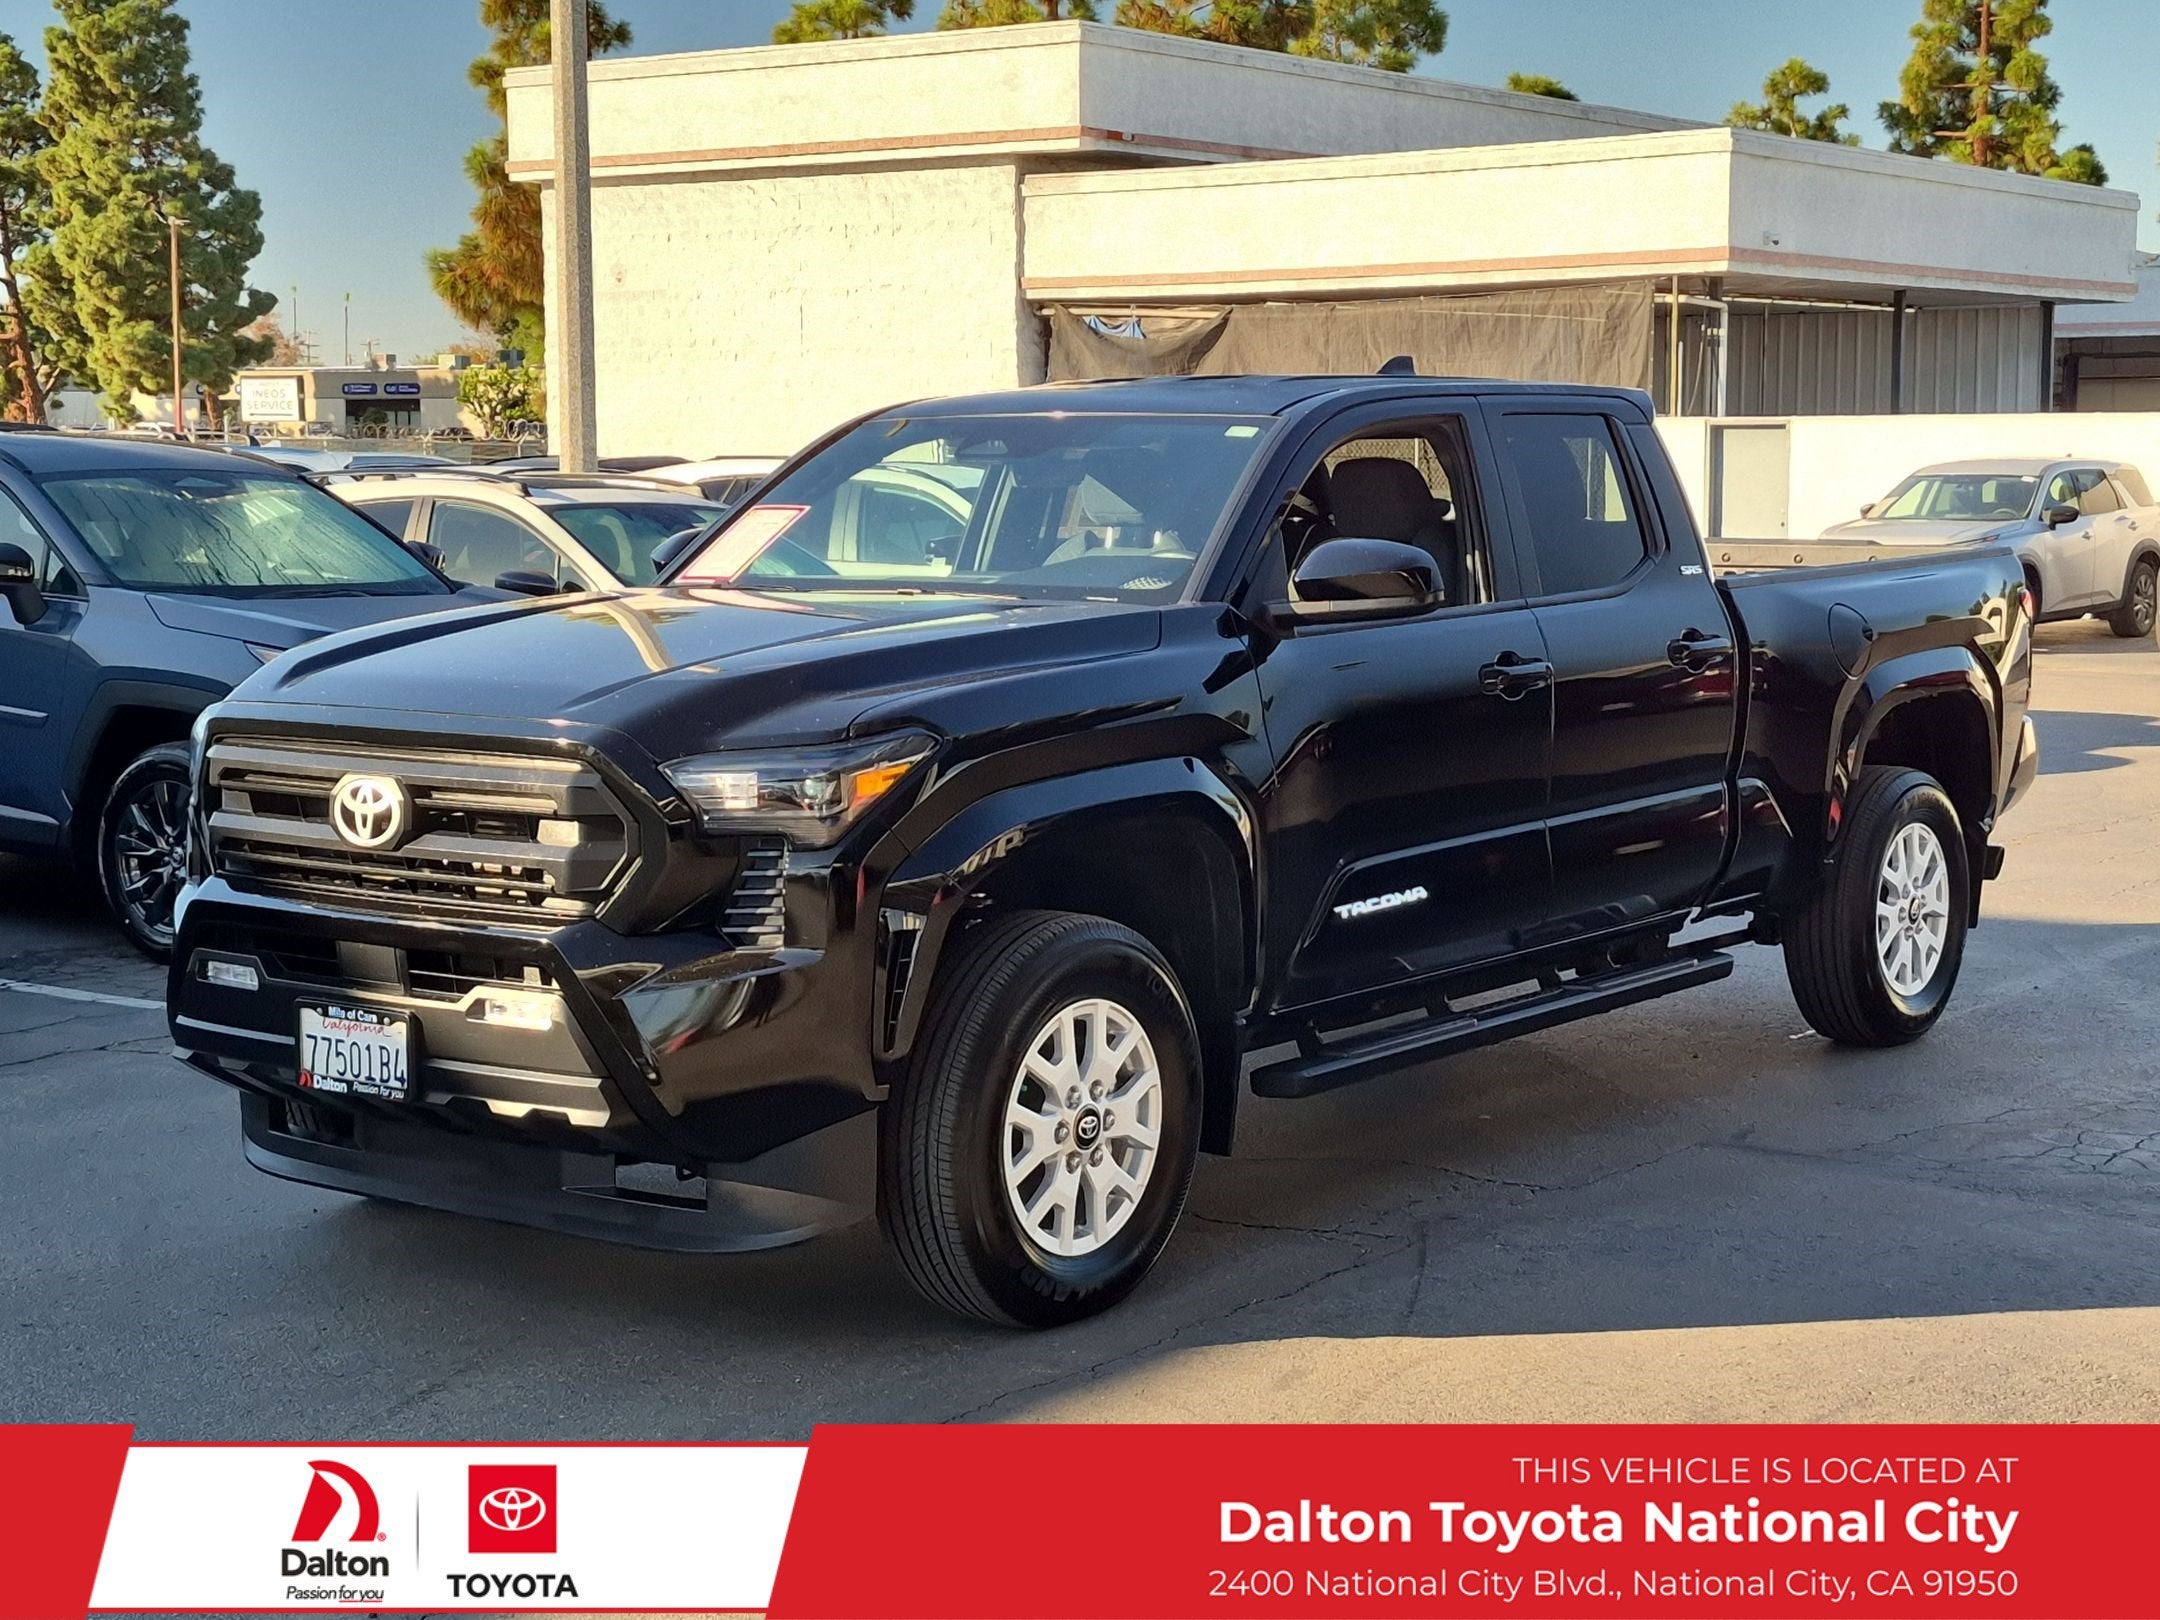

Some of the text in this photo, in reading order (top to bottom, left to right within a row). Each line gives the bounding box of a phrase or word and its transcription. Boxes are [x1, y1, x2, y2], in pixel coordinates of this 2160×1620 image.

[252, 388, 286, 399] INEOS
[246, 400, 293, 410] SERVICE
[1333, 886, 1428, 919] TACOMA
[347, 1009, 356, 1019] of
[322, 1019, 392, 1037] California
[306, 1034, 406, 1087] 77501B4
[313, 1074, 347, 1093] Dalton
[353, 1081, 404, 1099] Passion for you
